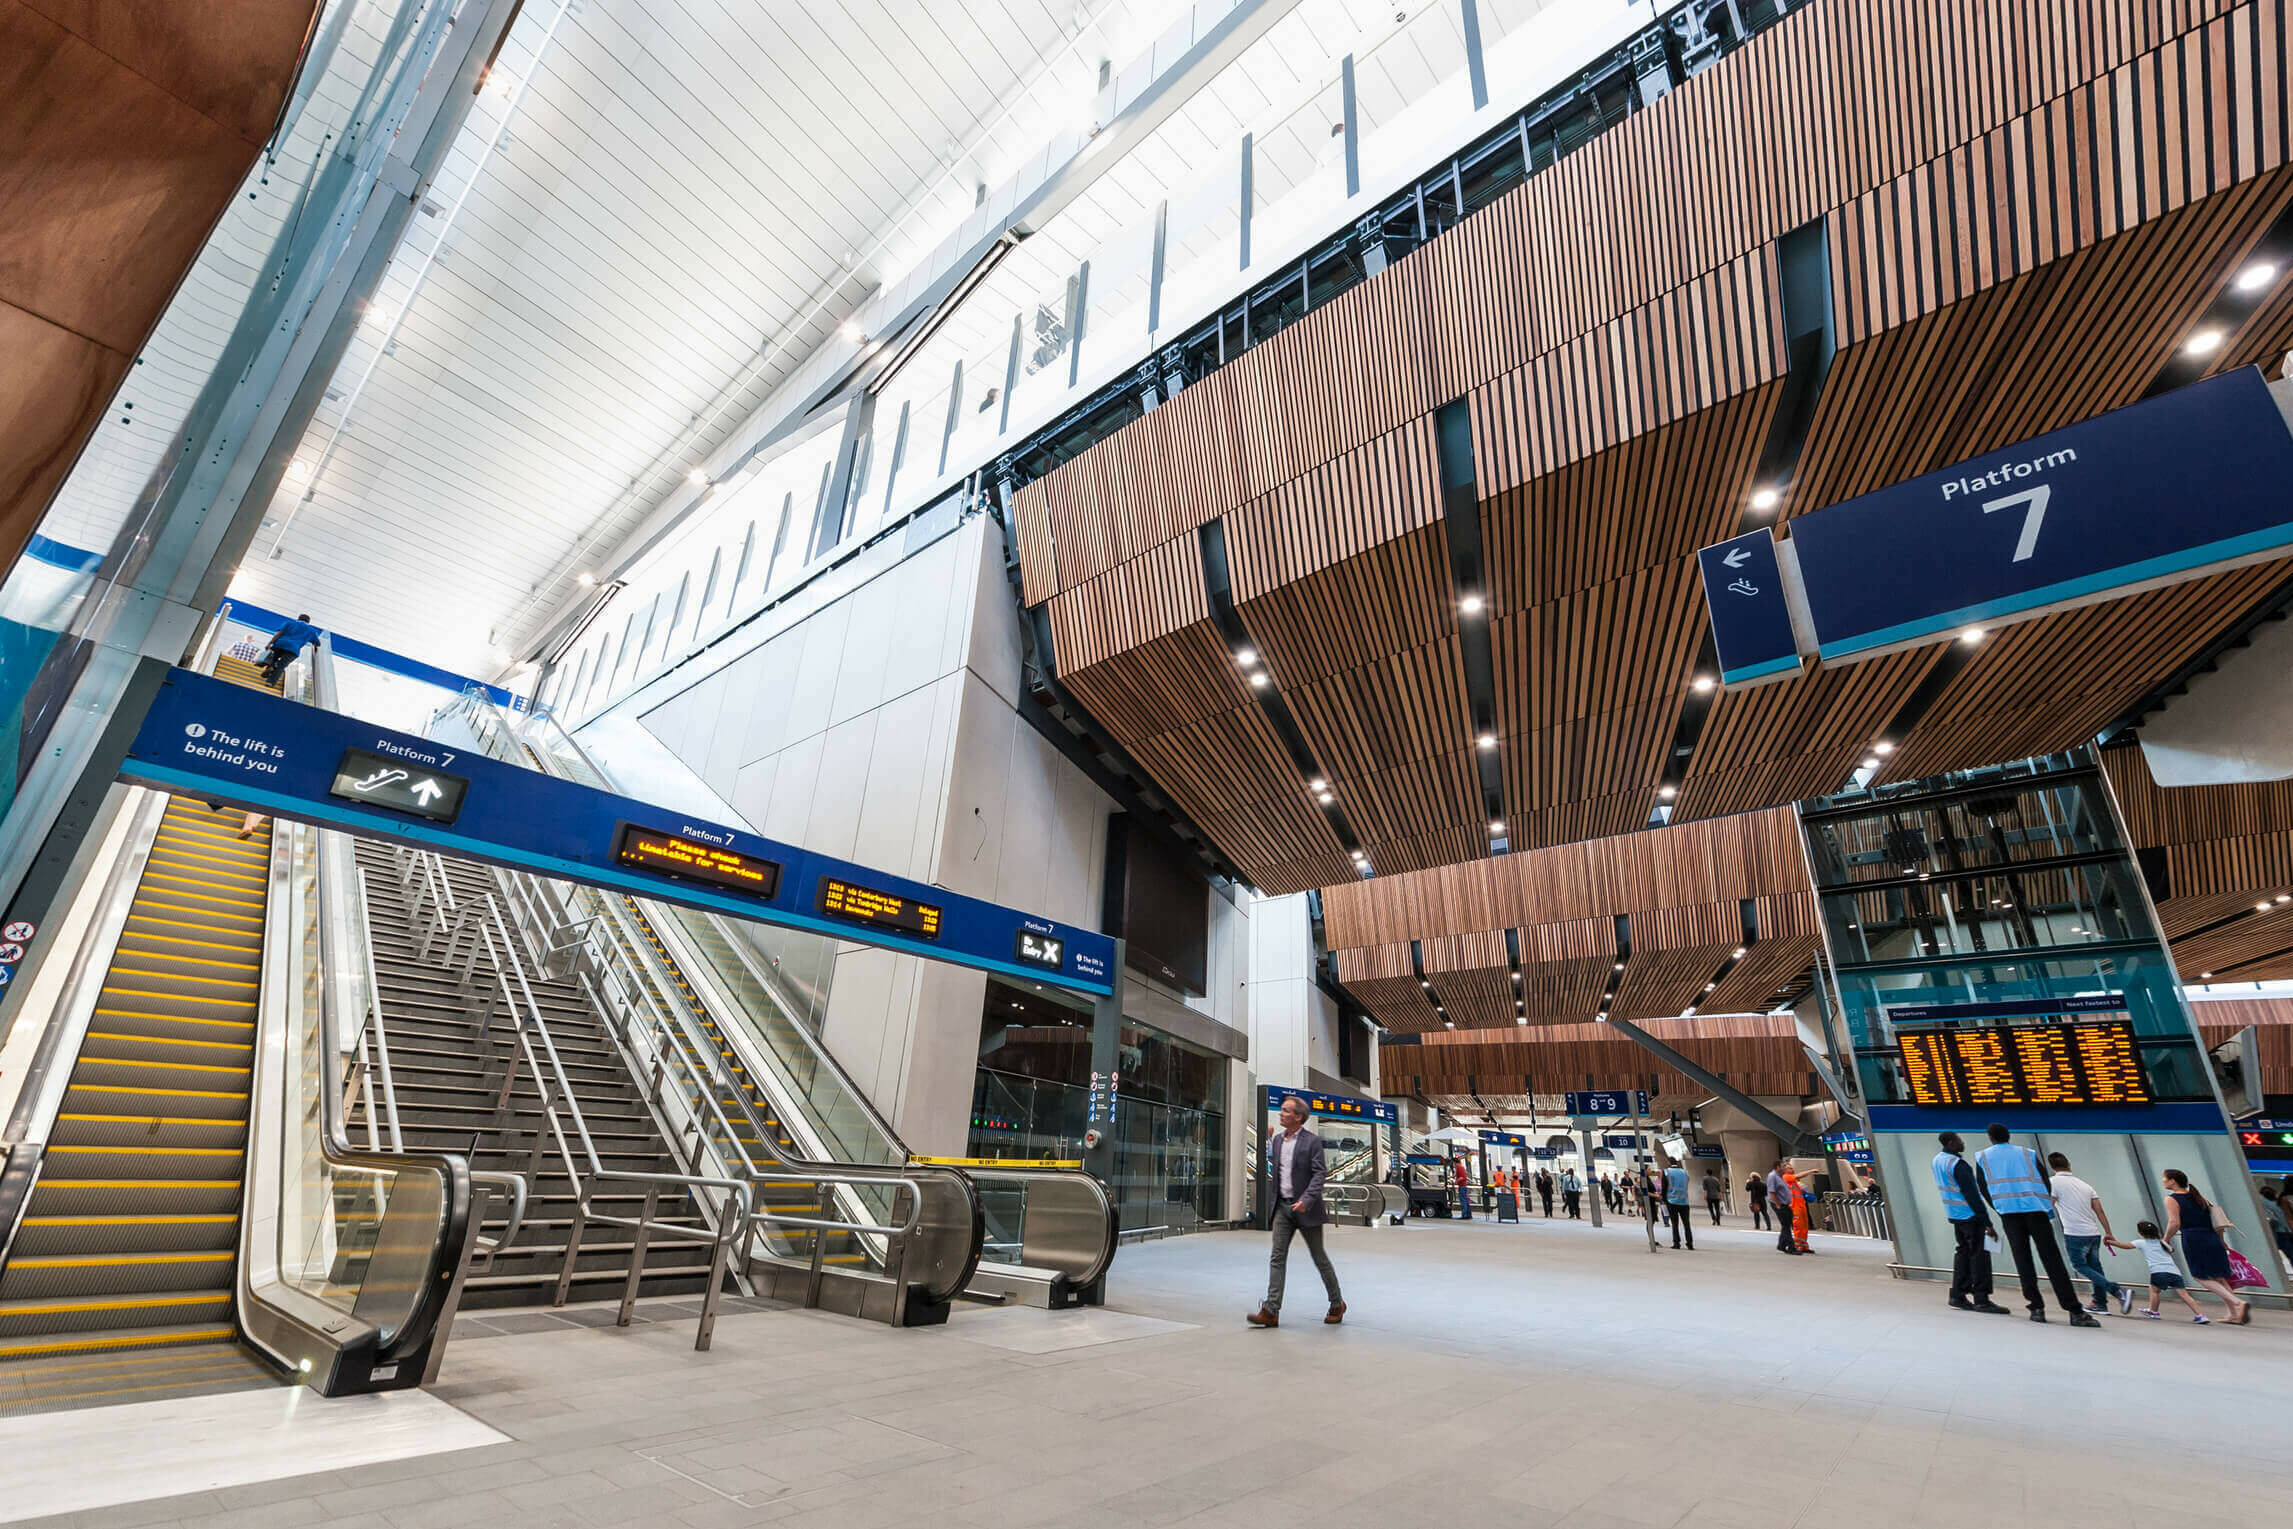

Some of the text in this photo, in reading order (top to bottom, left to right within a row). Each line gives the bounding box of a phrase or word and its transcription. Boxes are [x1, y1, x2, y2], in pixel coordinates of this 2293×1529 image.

[1941, 448, 2077, 502] Platform
[1982, 484, 2051, 563] 7
[212, 729, 285, 758] The lift is
[376, 740, 456, 767] Platform 7
[184, 741, 278, 774] behind you
[682, 825, 735, 846] Platform 7
[669, 839, 706, 857] Please
[695, 856, 715, 868] for
[717, 862, 764, 882] services
[1025, 920, 1054, 934] Platform 7
[1023, 944, 1042, 959] Entry
[1590, 1098, 1599, 1111] 8
[1607, 1098, 1616, 1111] 9
[1619, 1138, 1628, 1146] 10
